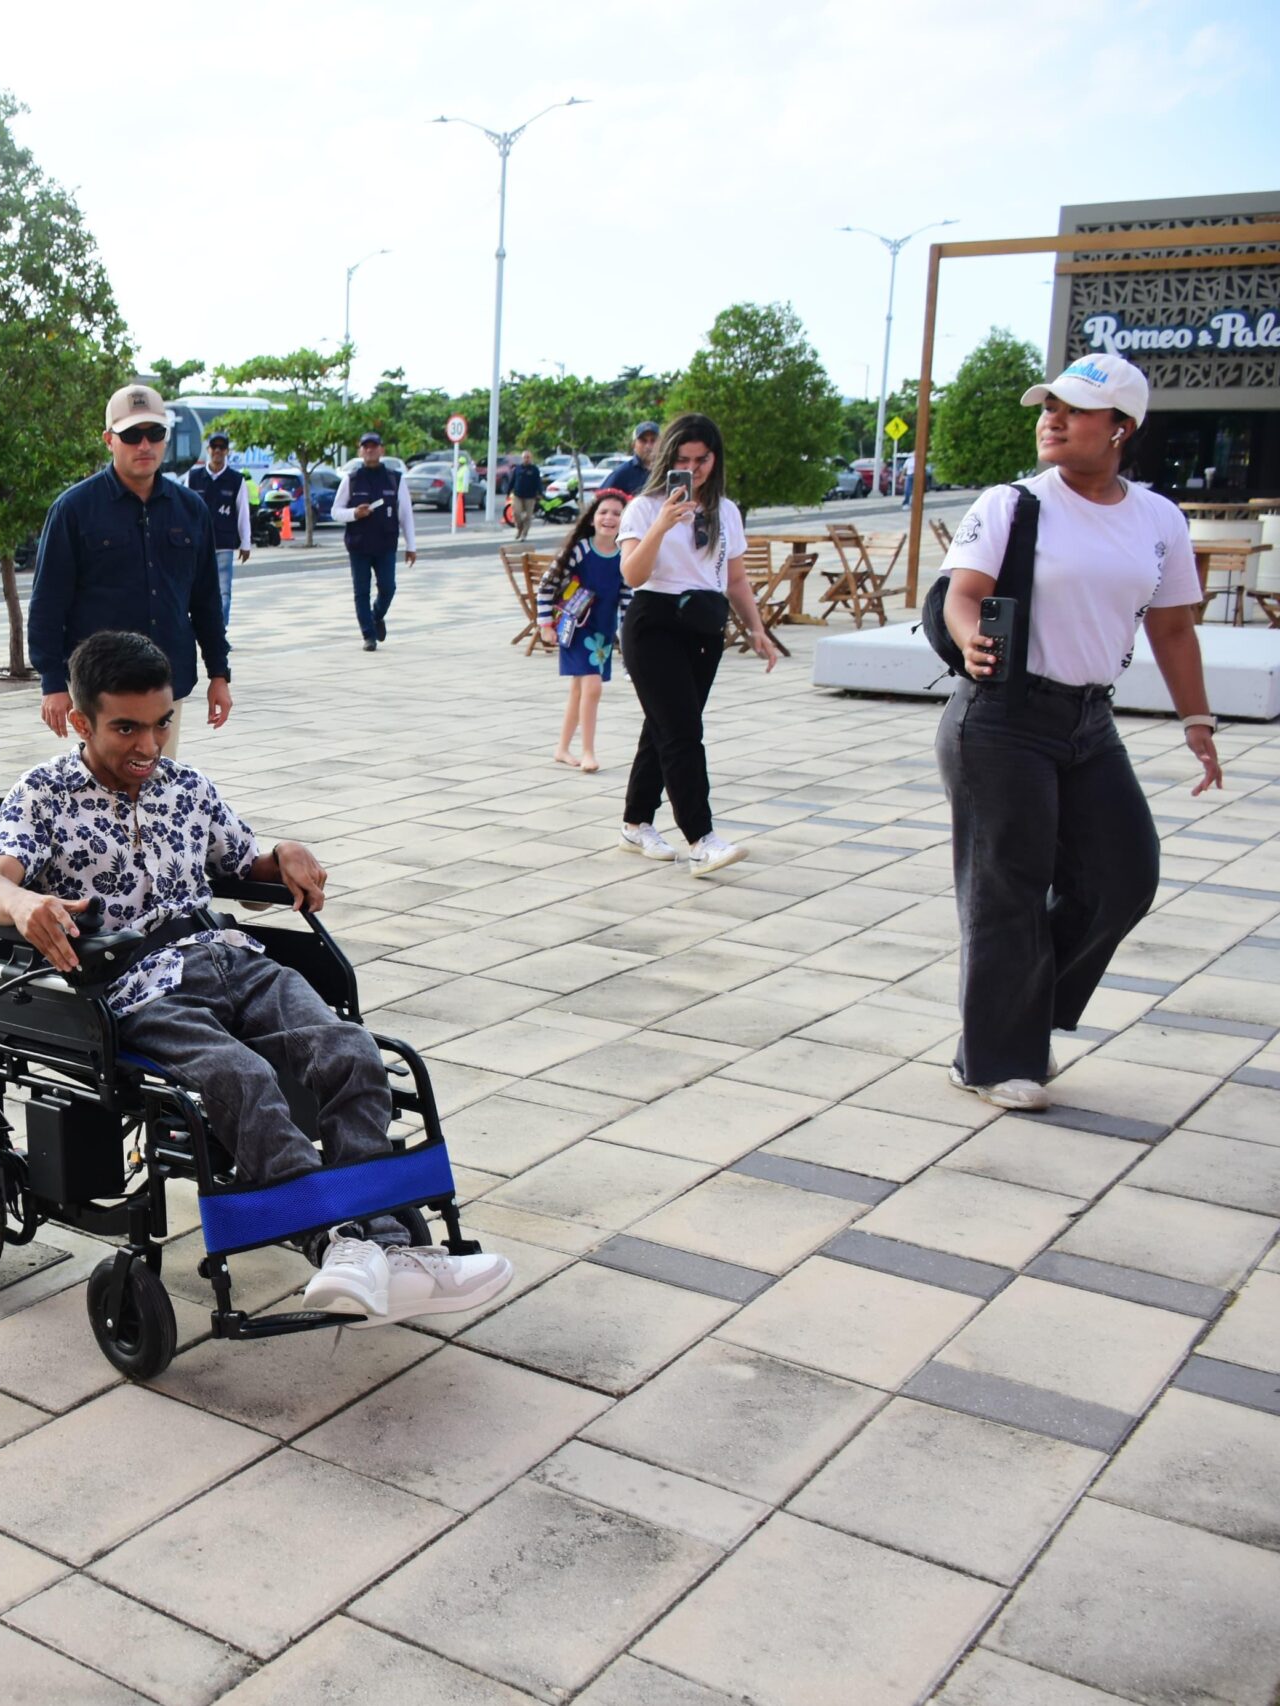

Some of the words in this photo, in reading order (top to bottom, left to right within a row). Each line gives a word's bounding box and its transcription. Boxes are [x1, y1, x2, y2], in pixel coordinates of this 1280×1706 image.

[1084, 315, 1194, 358] Romeo
[1197, 329, 1214, 347] &
[450, 422, 464, 436] 30
[219, 504, 232, 516] 44
